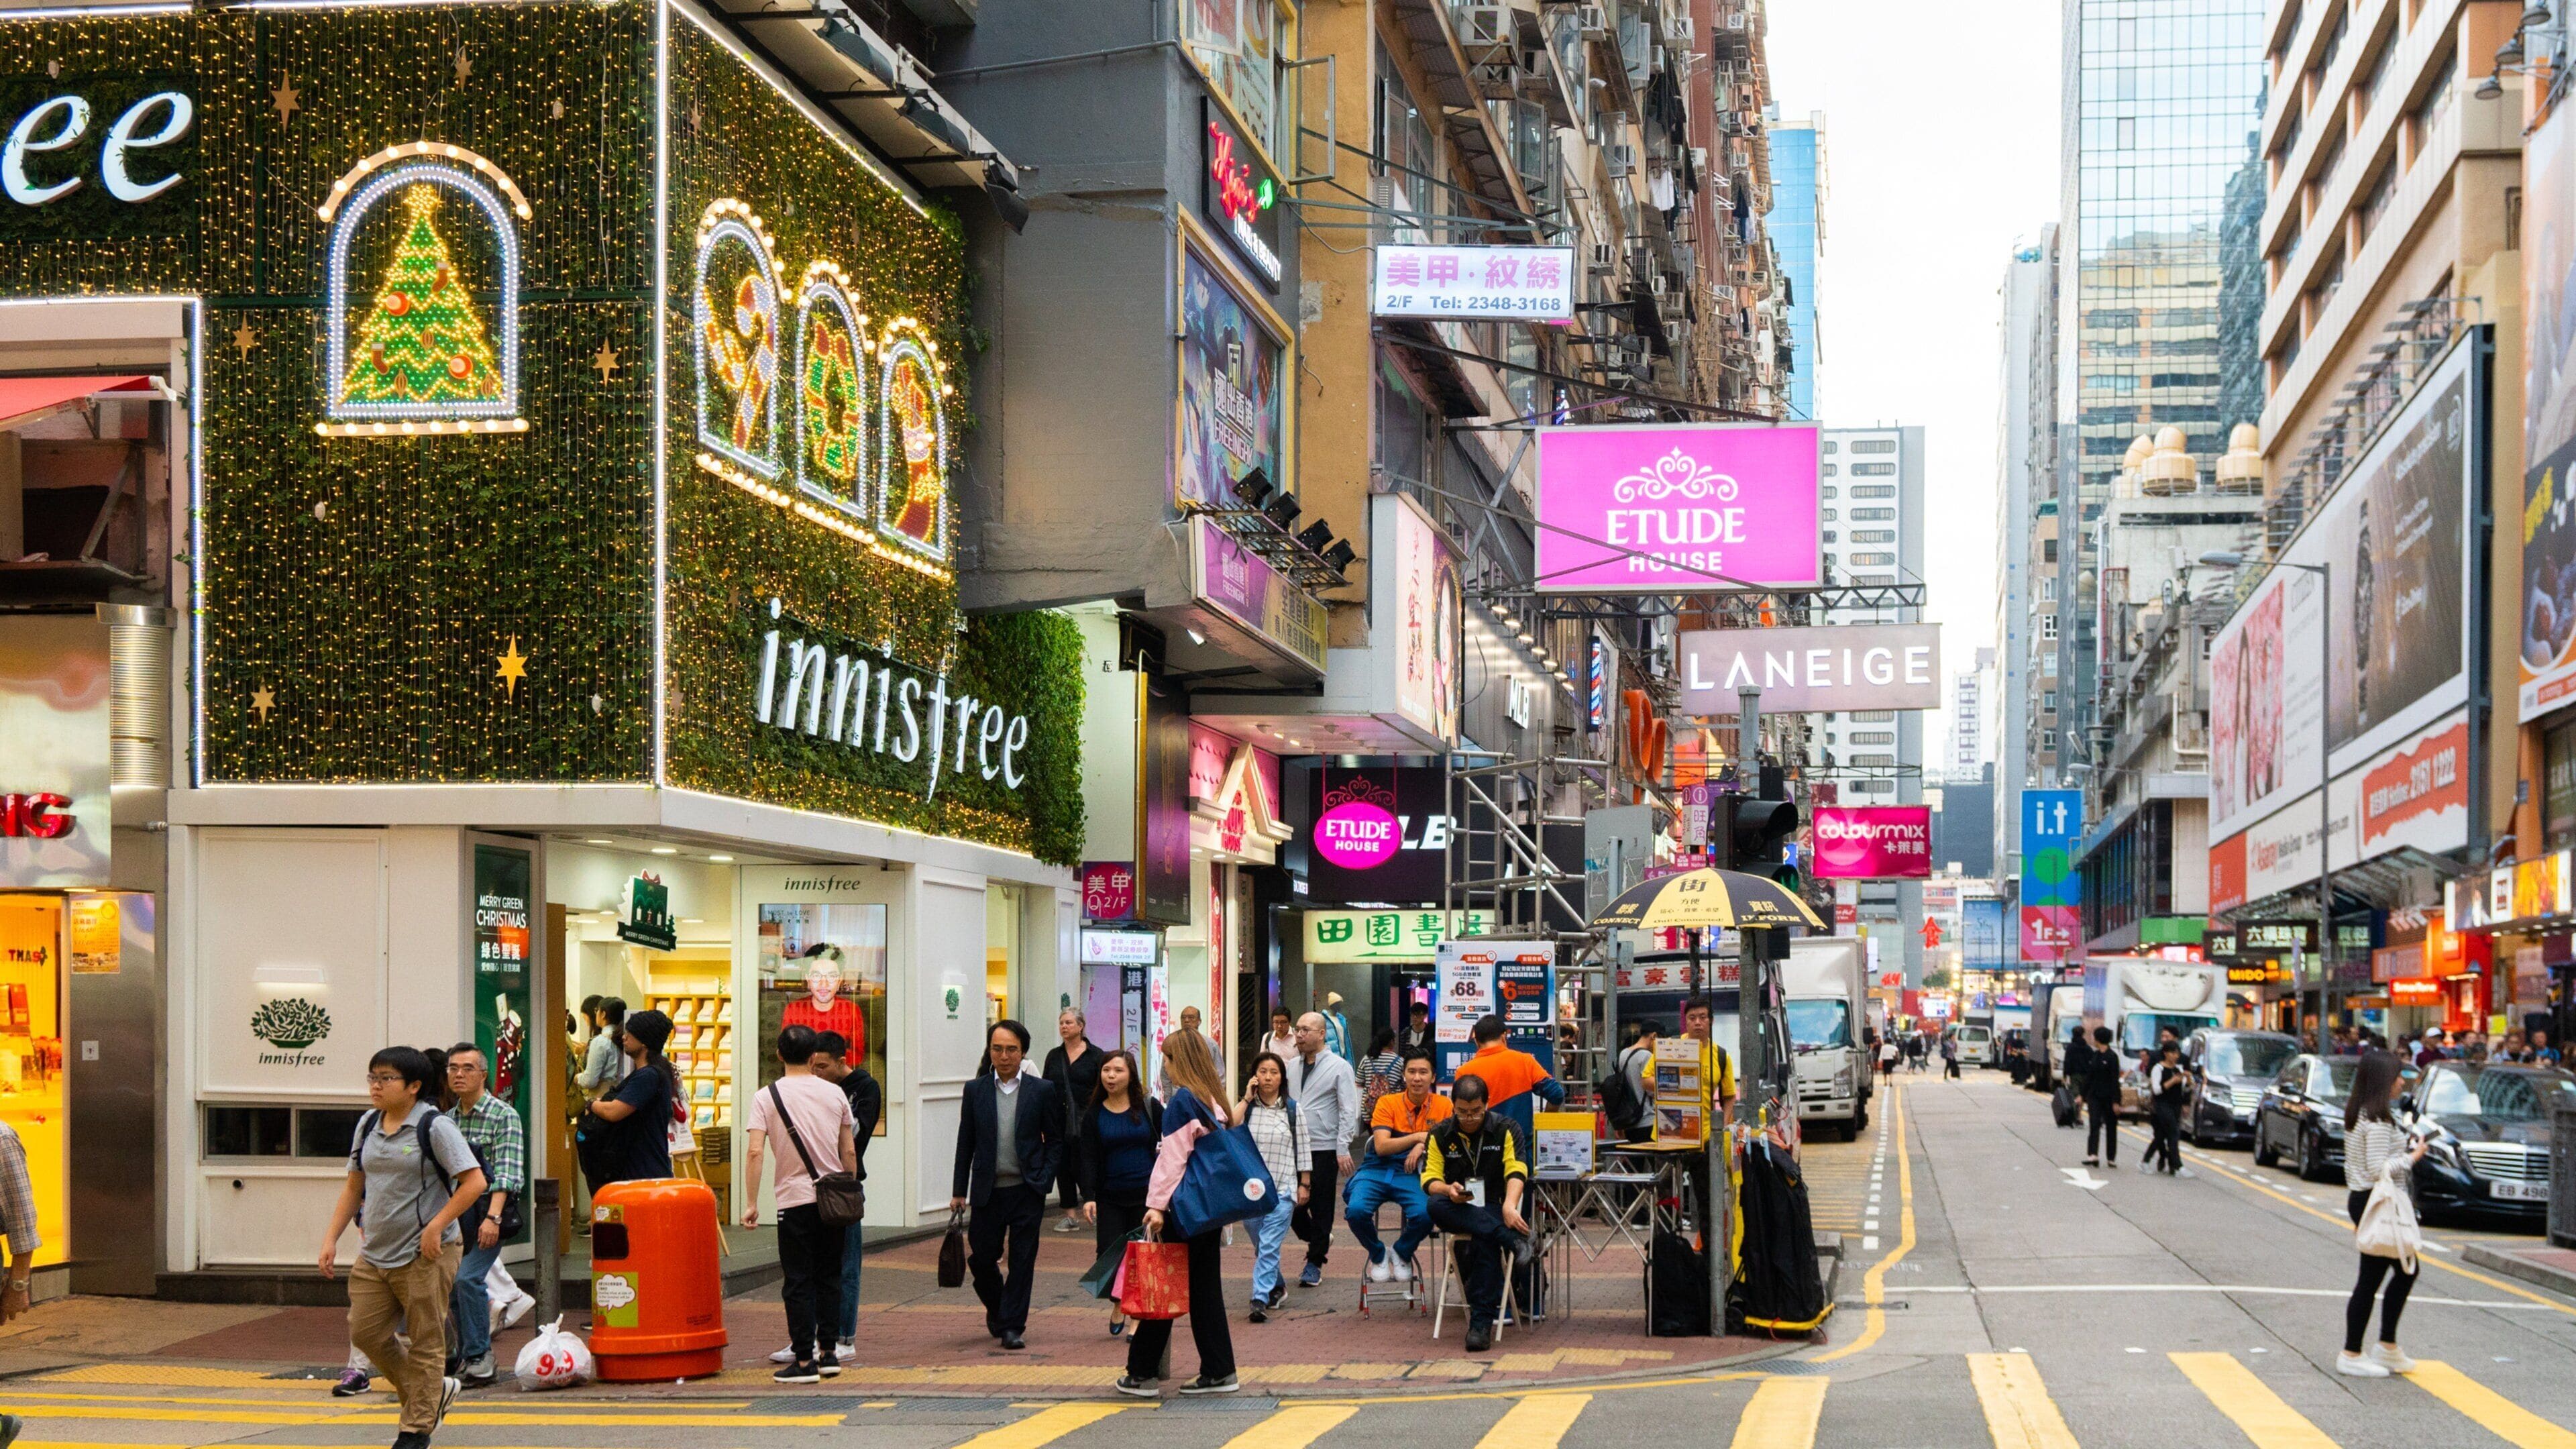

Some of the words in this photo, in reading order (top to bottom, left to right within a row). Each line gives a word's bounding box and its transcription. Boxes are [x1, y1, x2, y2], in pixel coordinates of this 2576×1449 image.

[1, 92, 193, 206] ee
[1387, 295, 1413, 308] 2/F
[1430, 296, 1462, 309] Tel:
[1468, 297, 1561, 311] 2348-3168
[1215, 417, 1254, 469] FREEINGHK
[1606, 507, 1747, 545] ETUDE
[1629, 550, 1723, 573] HOUSE
[1690, 645, 1932, 690] LANEIGE
[757, 597, 1028, 804] innisfree
[1510, 674, 1529, 730] MLB
[2037, 801, 2068, 835] i.t
[1326, 819, 1392, 840] ETUDE
[1397, 815, 1457, 850] LB
[1818, 821, 1925, 839] colourmix
[1335, 840, 1380, 853] HOUSE
[784, 875, 861, 894] innisfree
[1087, 874, 1130, 894] 美甲
[480, 895, 502, 908] MERRY
[502, 897, 523, 910] GREEN
[1104, 896, 1128, 908] 2/F
[476, 909, 527, 929] CHRISTMAS
[2031, 918, 2053, 940] 1F
[2229, 969, 2265, 981] MIDO
[1126, 1008, 1137, 1033] 2/F
[258, 1051, 325, 1068] innisfree
